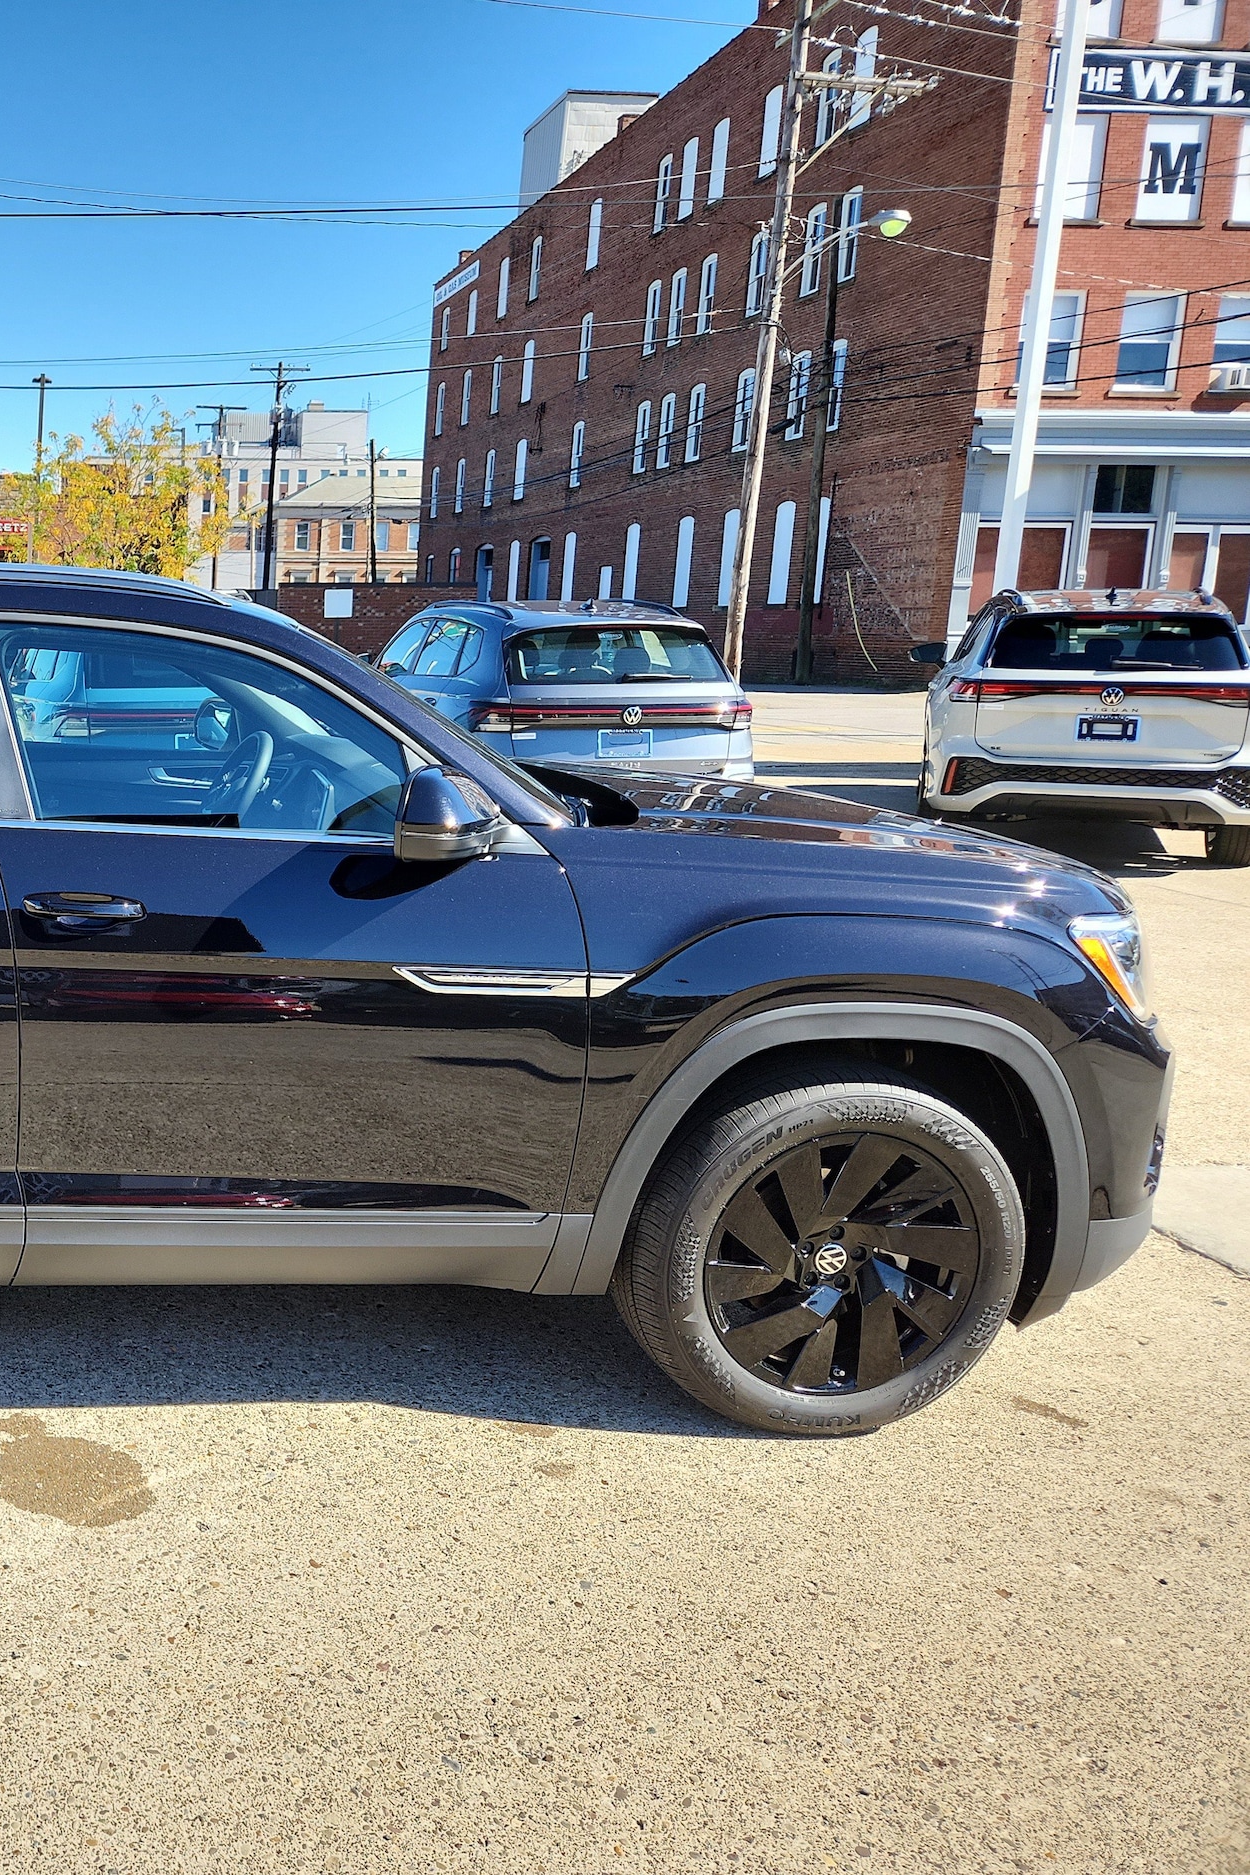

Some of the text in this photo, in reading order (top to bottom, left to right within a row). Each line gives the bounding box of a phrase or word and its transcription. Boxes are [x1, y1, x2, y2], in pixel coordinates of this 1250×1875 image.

[1143, 142, 1203, 195] M
[788, 1117, 815, 1134] HP71
[979, 1165, 1007, 1209] 255/50
[1000, 1210, 1012, 1239] R20
